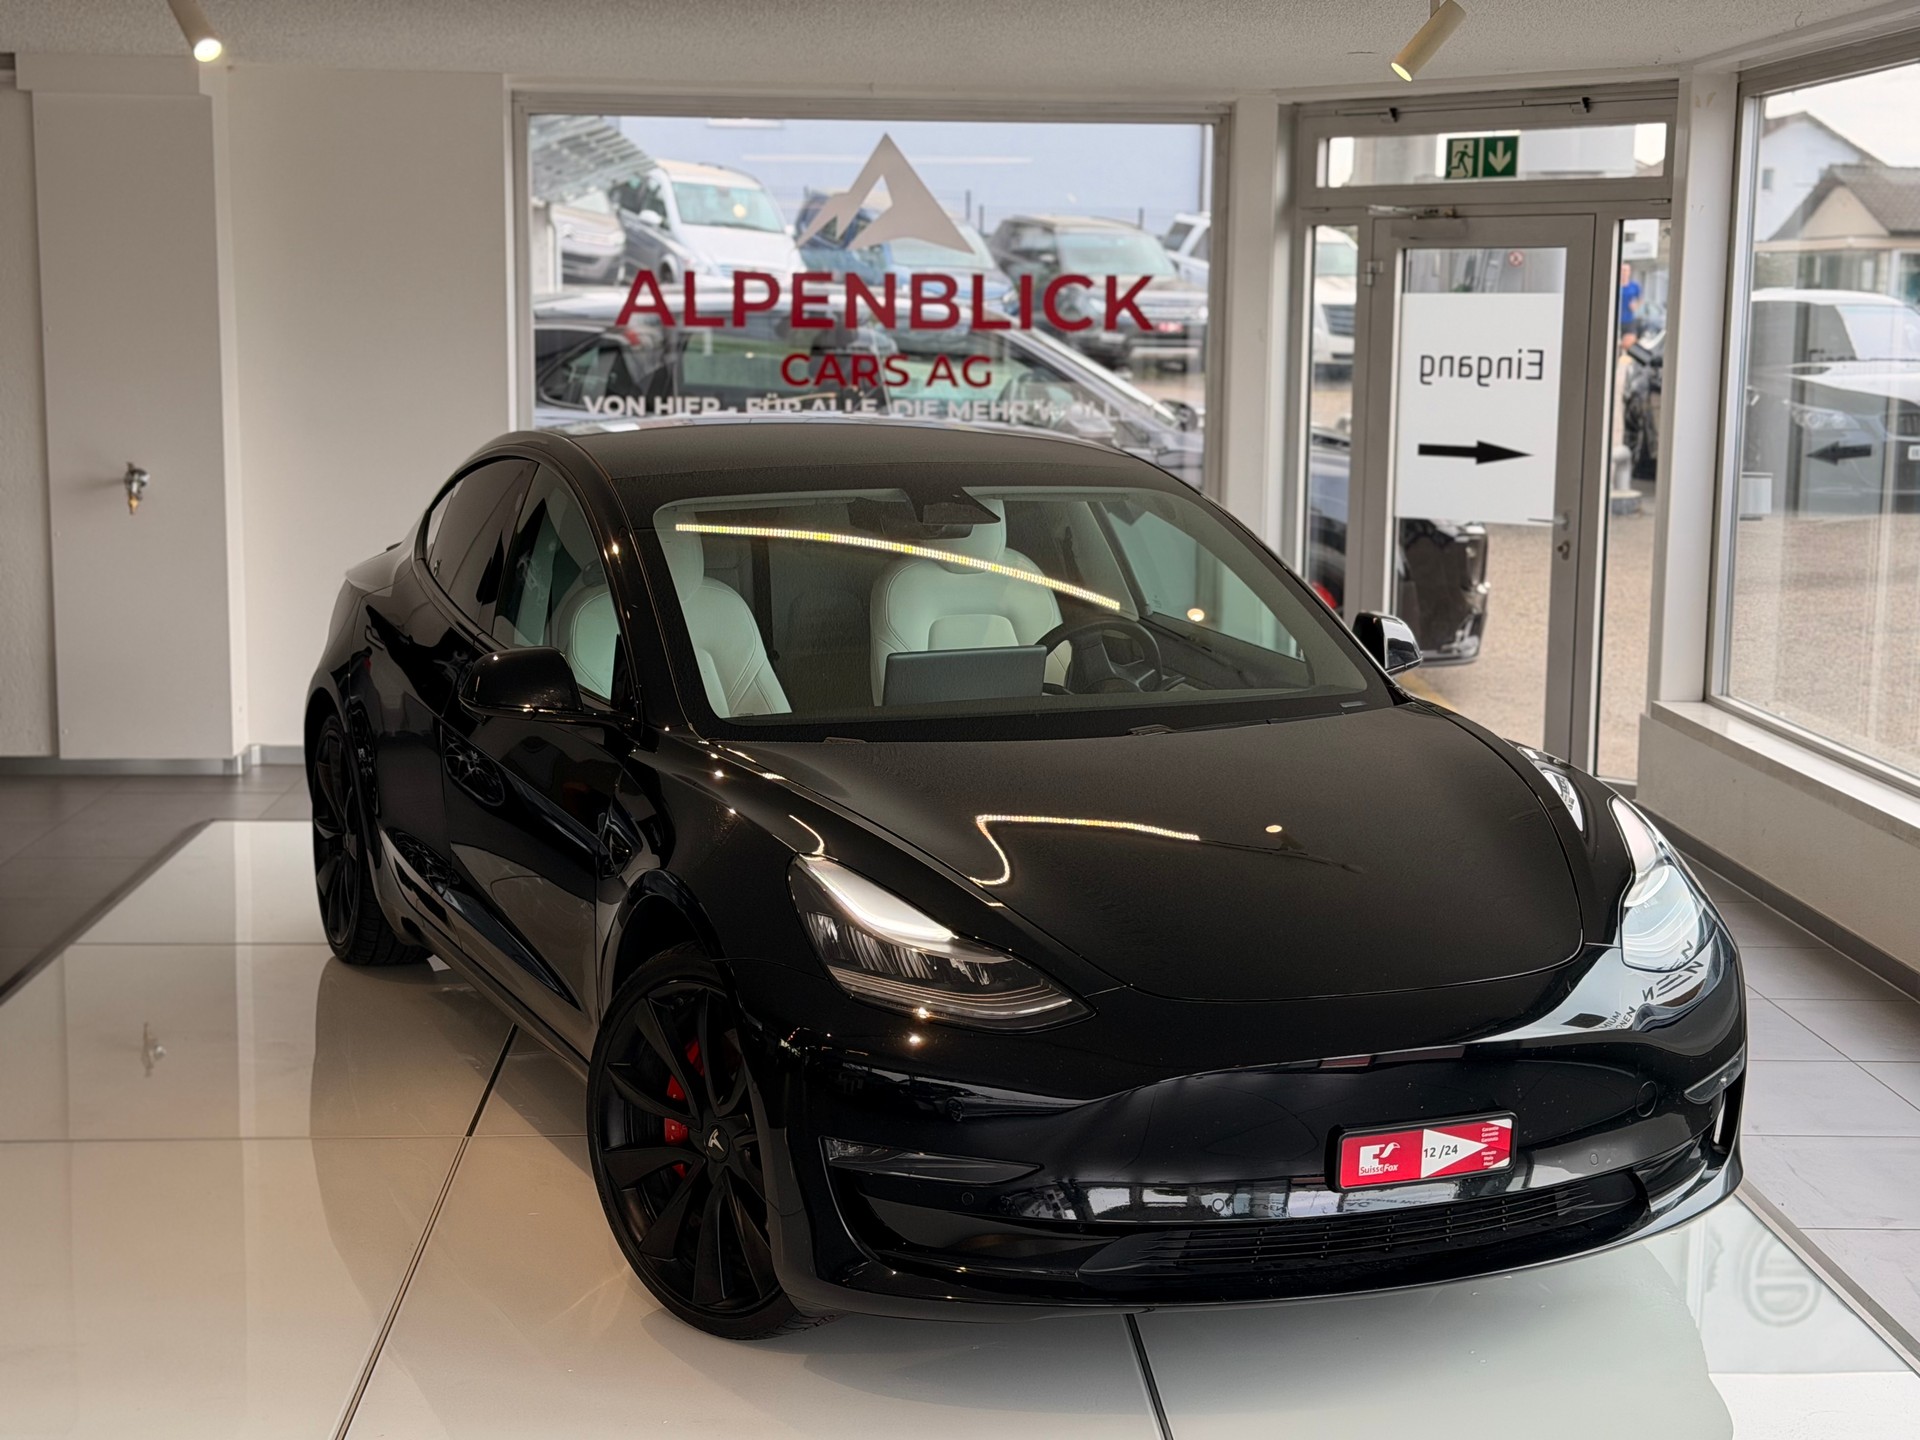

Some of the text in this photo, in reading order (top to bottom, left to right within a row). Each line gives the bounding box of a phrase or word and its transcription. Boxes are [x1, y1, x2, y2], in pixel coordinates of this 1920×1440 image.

[615, 269, 1154, 332] ALPENBLICK
[780, 353, 992, 388] CARS AG
[583, 395, 646, 416] VON
[947, 399, 1028, 422] MEHR
[1423, 1148, 1436, 1158] 12
